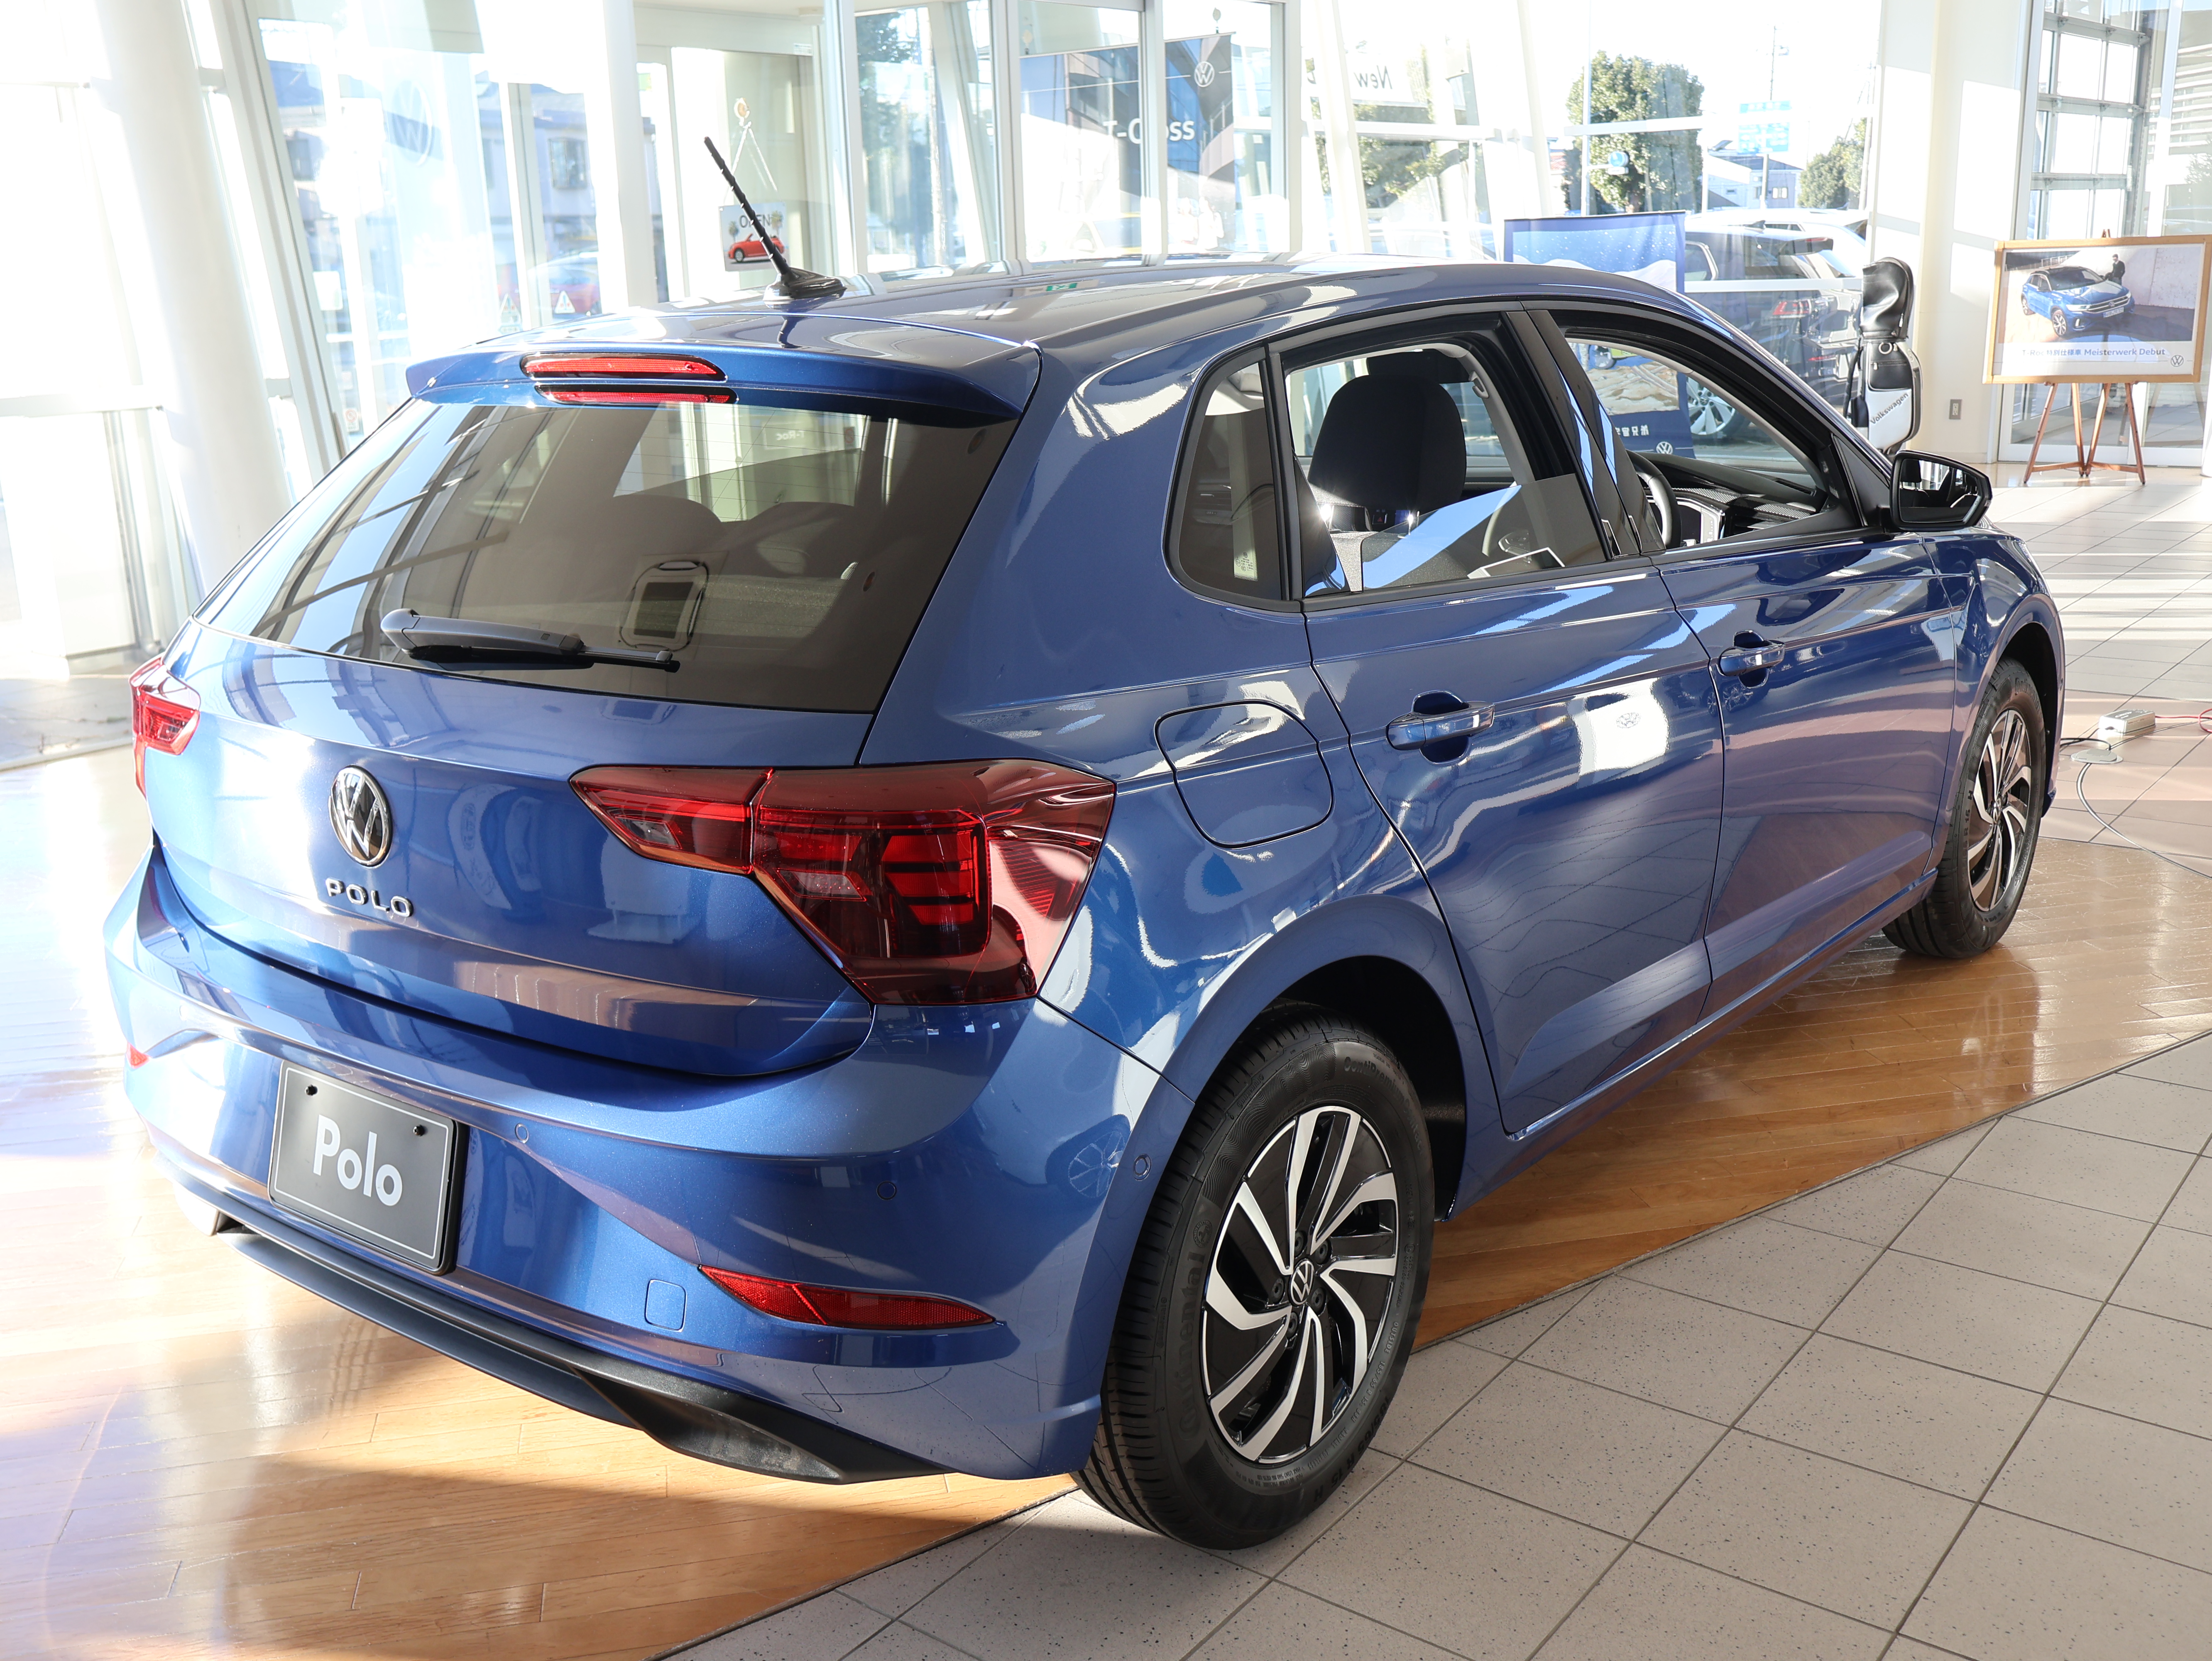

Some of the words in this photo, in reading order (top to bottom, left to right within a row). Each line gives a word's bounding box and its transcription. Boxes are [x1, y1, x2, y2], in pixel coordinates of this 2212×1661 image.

[1103, 118, 1195, 144] T-Css
[1869, 392, 1909, 424] Volkswagen
[325, 877, 414, 918] POLO
[313, 1114, 403, 1206] Polo
[1385, 1321, 1399, 1354] OUTSIDE
